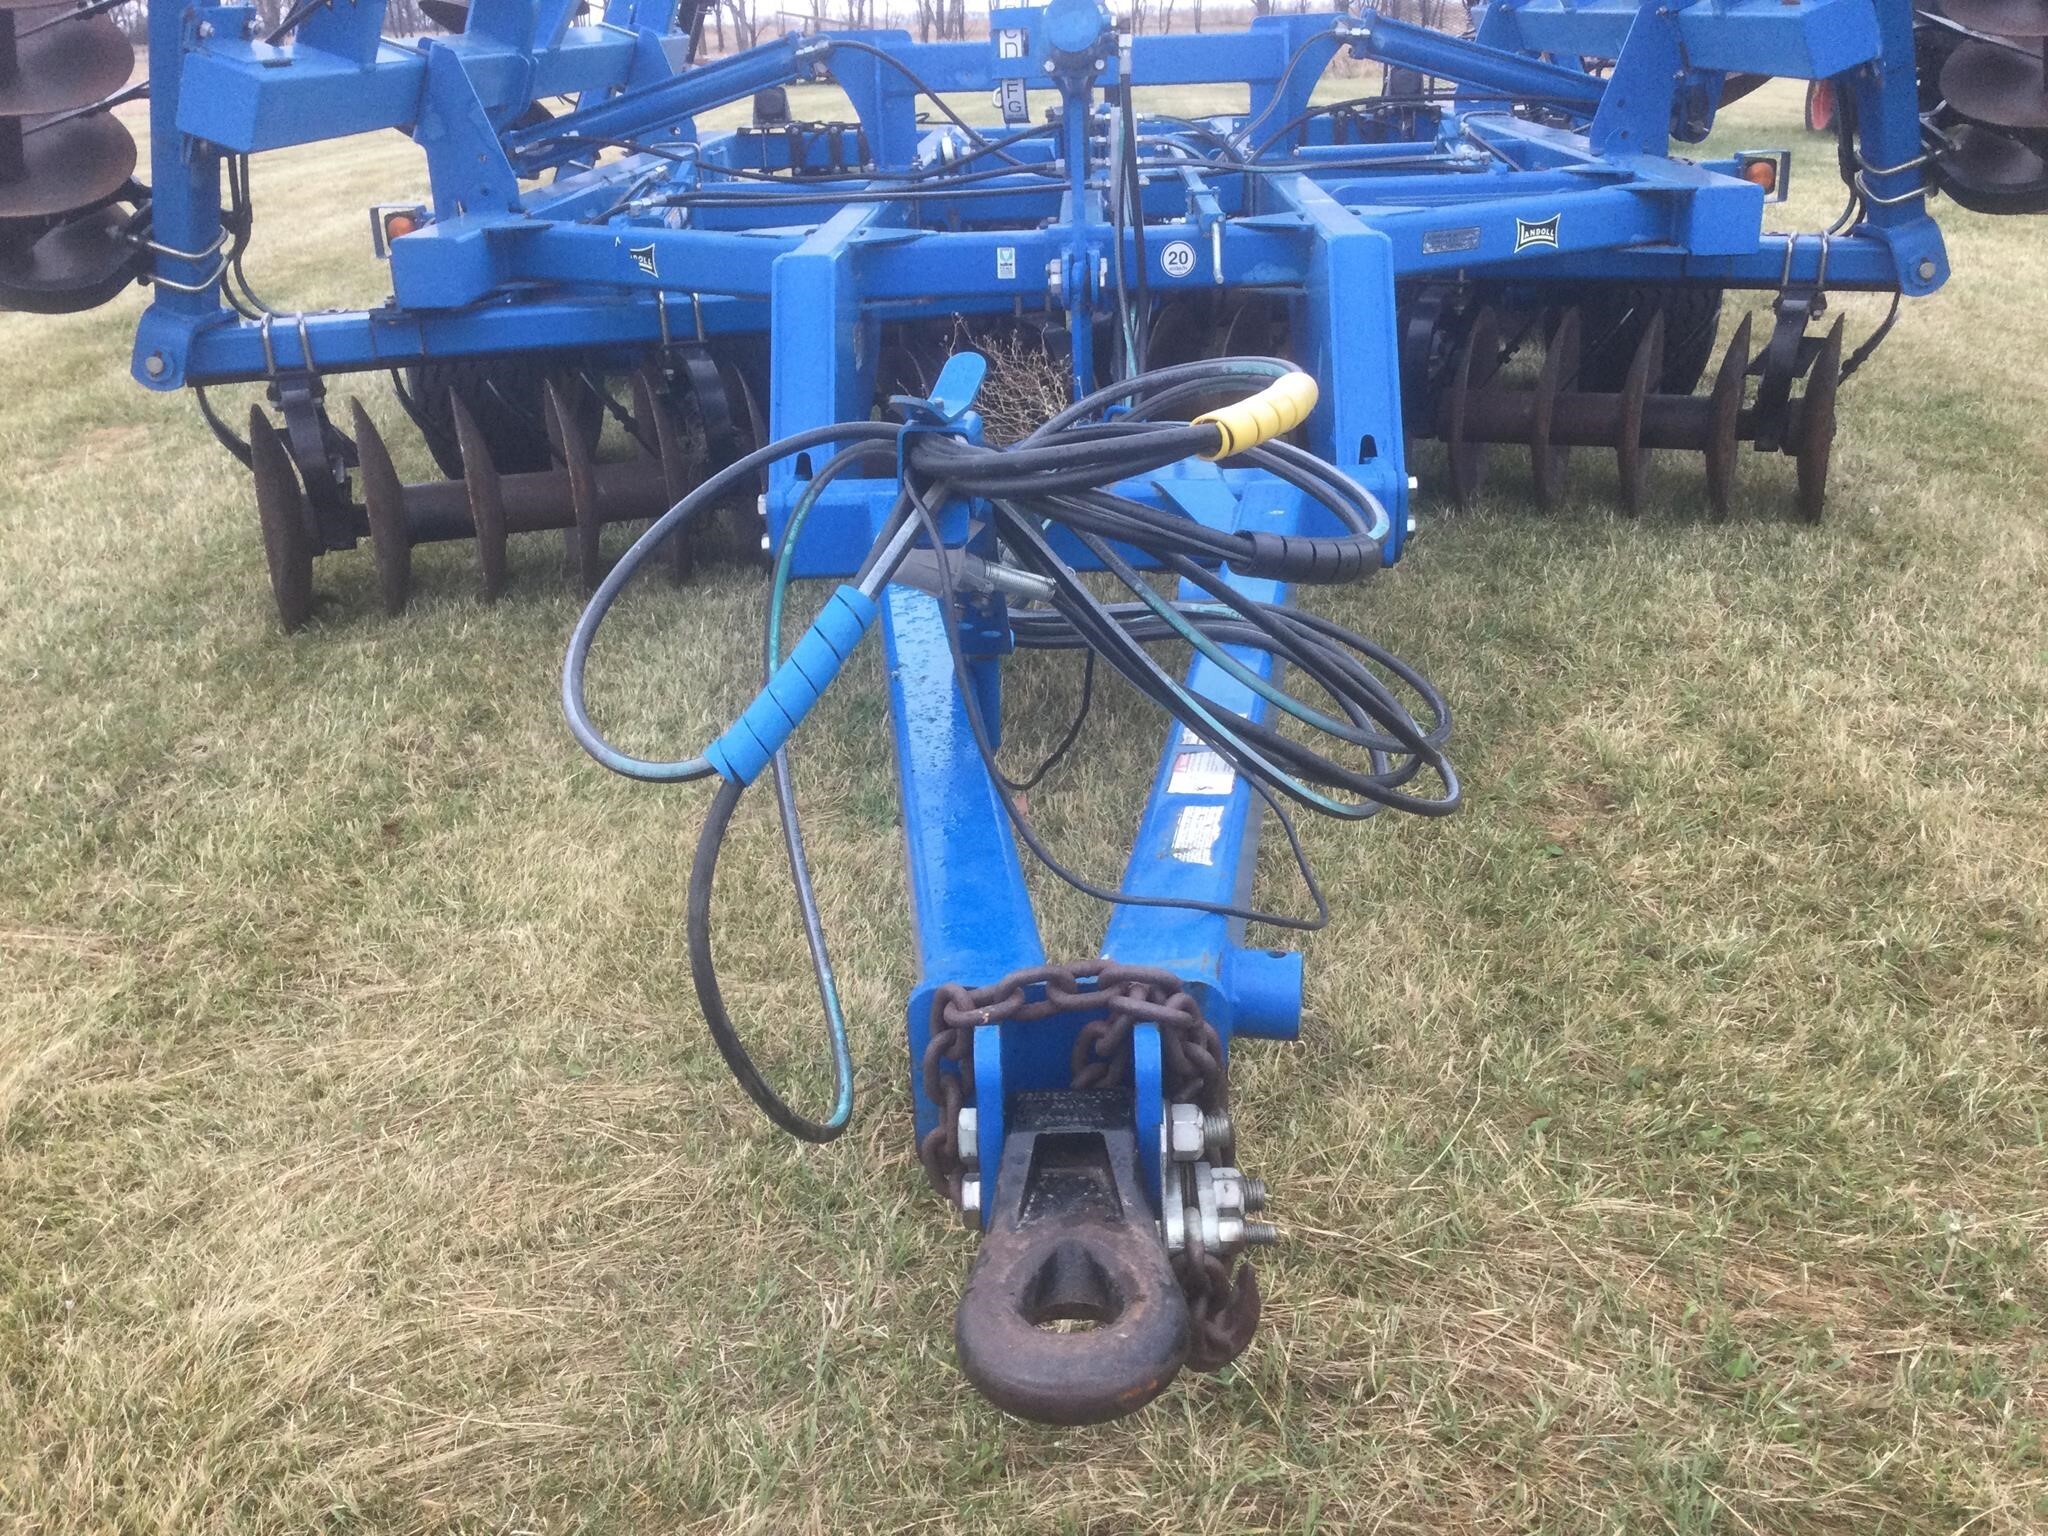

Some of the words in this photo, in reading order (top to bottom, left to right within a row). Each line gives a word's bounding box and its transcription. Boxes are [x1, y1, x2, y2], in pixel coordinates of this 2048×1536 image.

[1006, 83, 1018, 99] F
[1008, 100, 1021, 113] G
[1520, 224, 1554, 244] LANDOLL
[1168, 250, 1188, 265] 20
